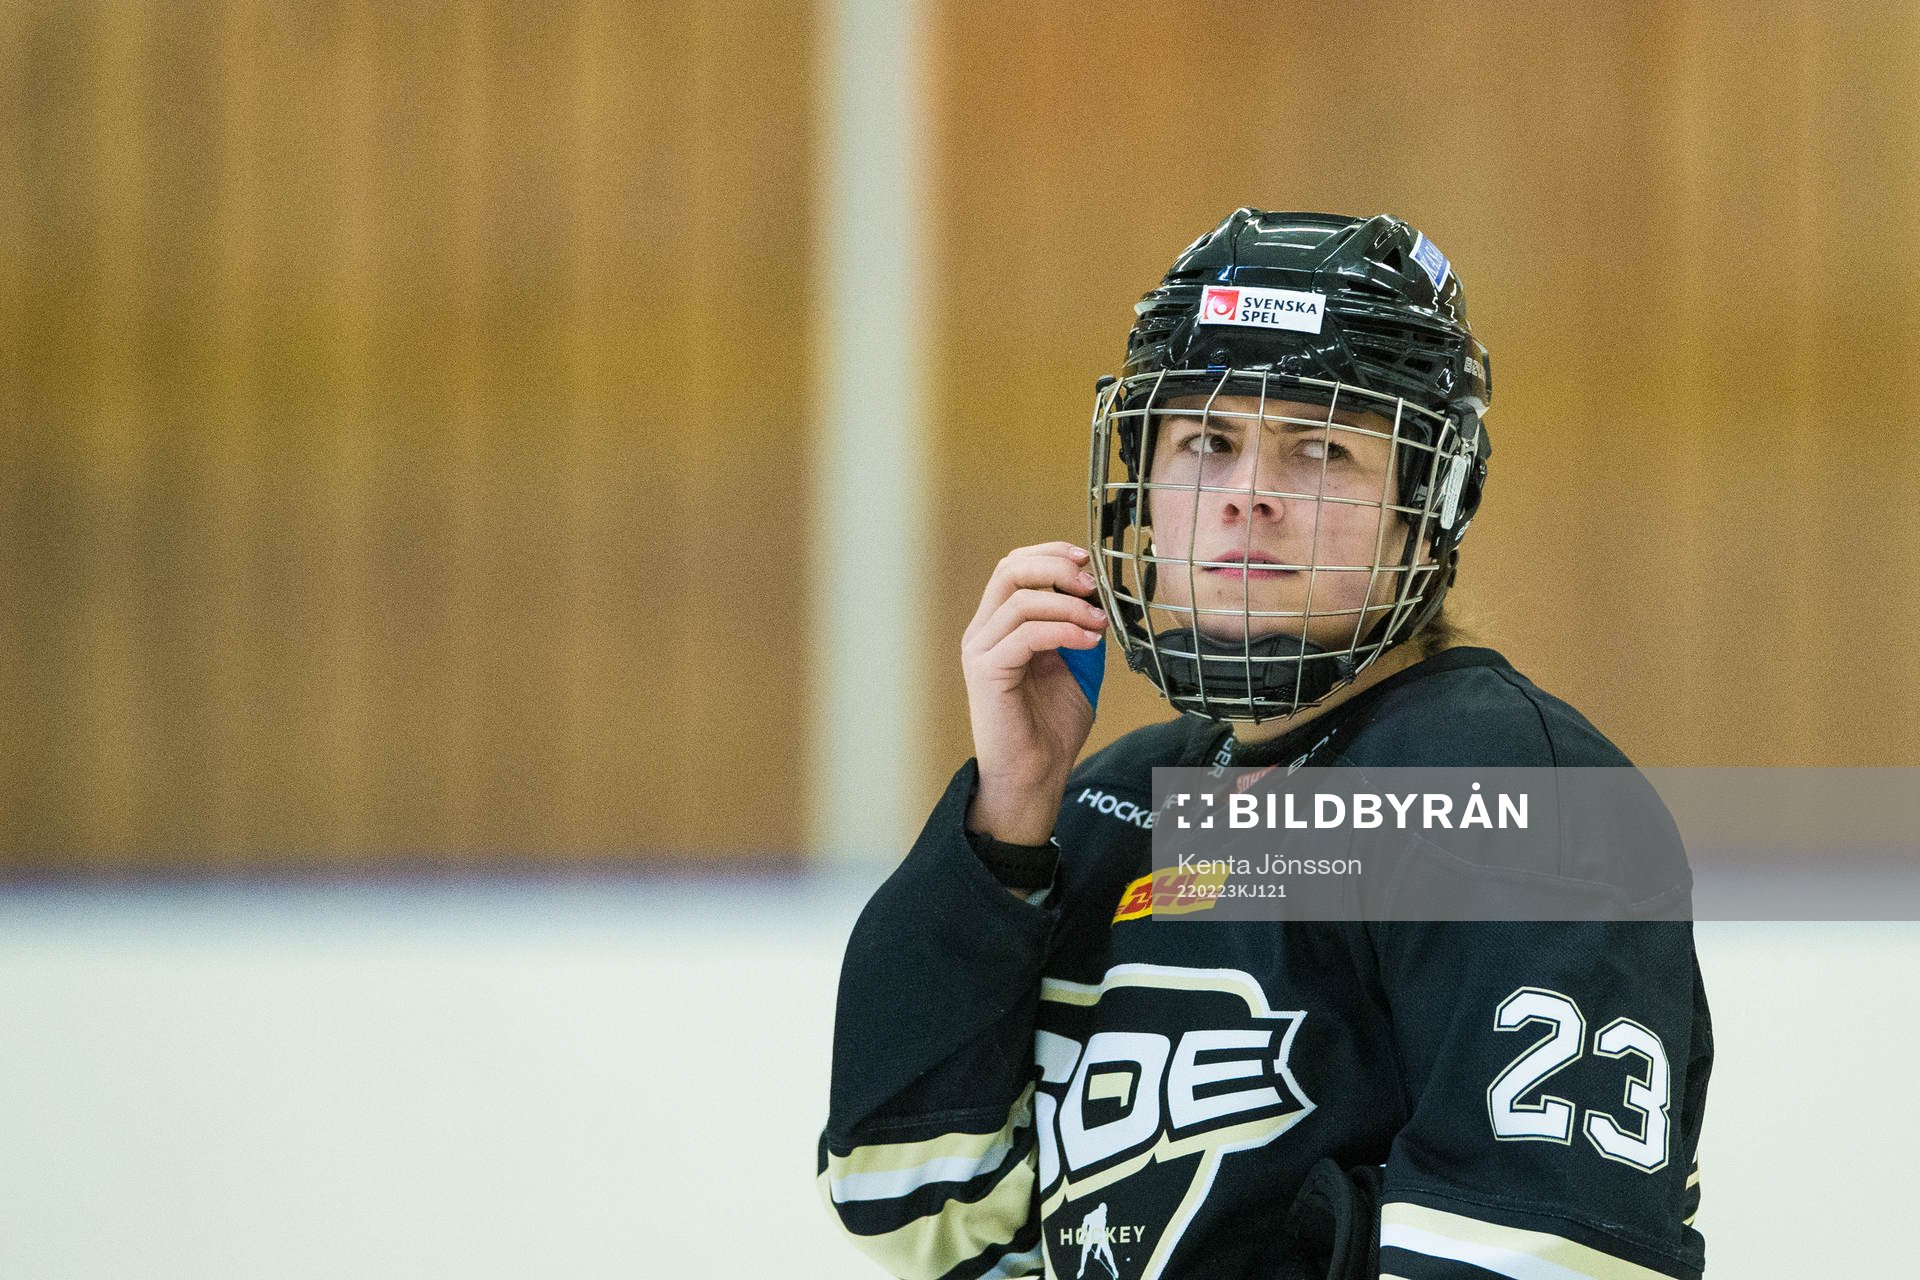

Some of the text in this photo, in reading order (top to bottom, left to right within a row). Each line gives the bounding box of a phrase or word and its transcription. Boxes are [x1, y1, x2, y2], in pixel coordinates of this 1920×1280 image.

[1243, 296, 1318, 315] SVENSKA
[1240, 310, 1280, 325] SPEL
[1486, 985, 1671, 1175] 23
[1060, 1225, 1146, 1246] HOKEY
